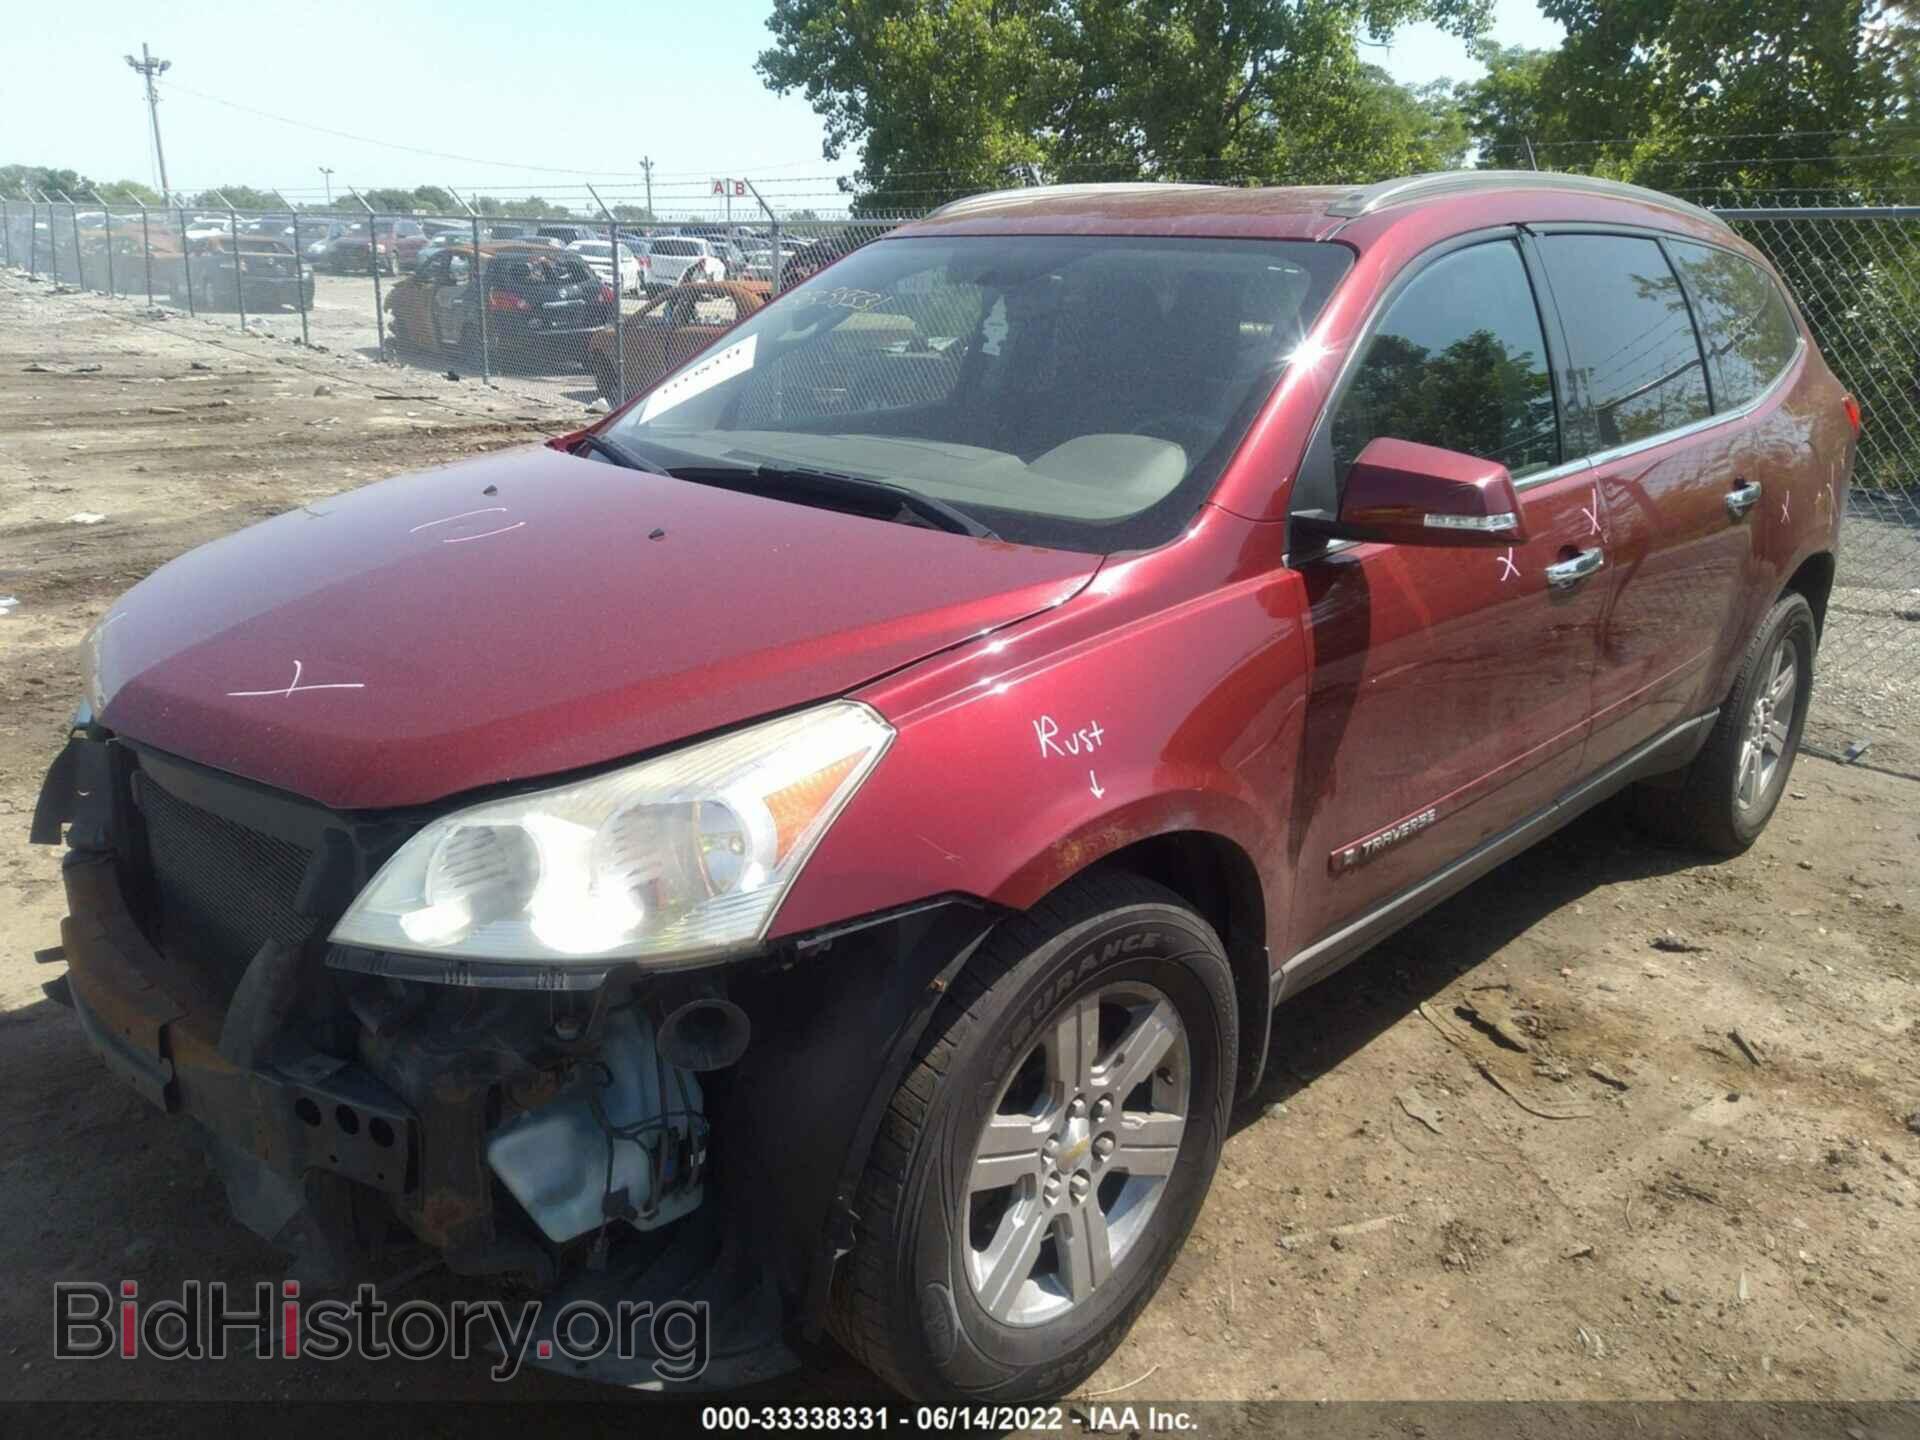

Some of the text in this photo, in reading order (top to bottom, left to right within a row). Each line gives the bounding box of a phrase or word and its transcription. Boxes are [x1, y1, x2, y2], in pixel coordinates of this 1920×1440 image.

[713, 180, 725, 195] A
[735, 180, 745, 196] B
[1032, 714, 1105, 759] Rust
[1361, 807, 1437, 857] TRAVERSE
[978, 931, 1161, 1110] URANCE
